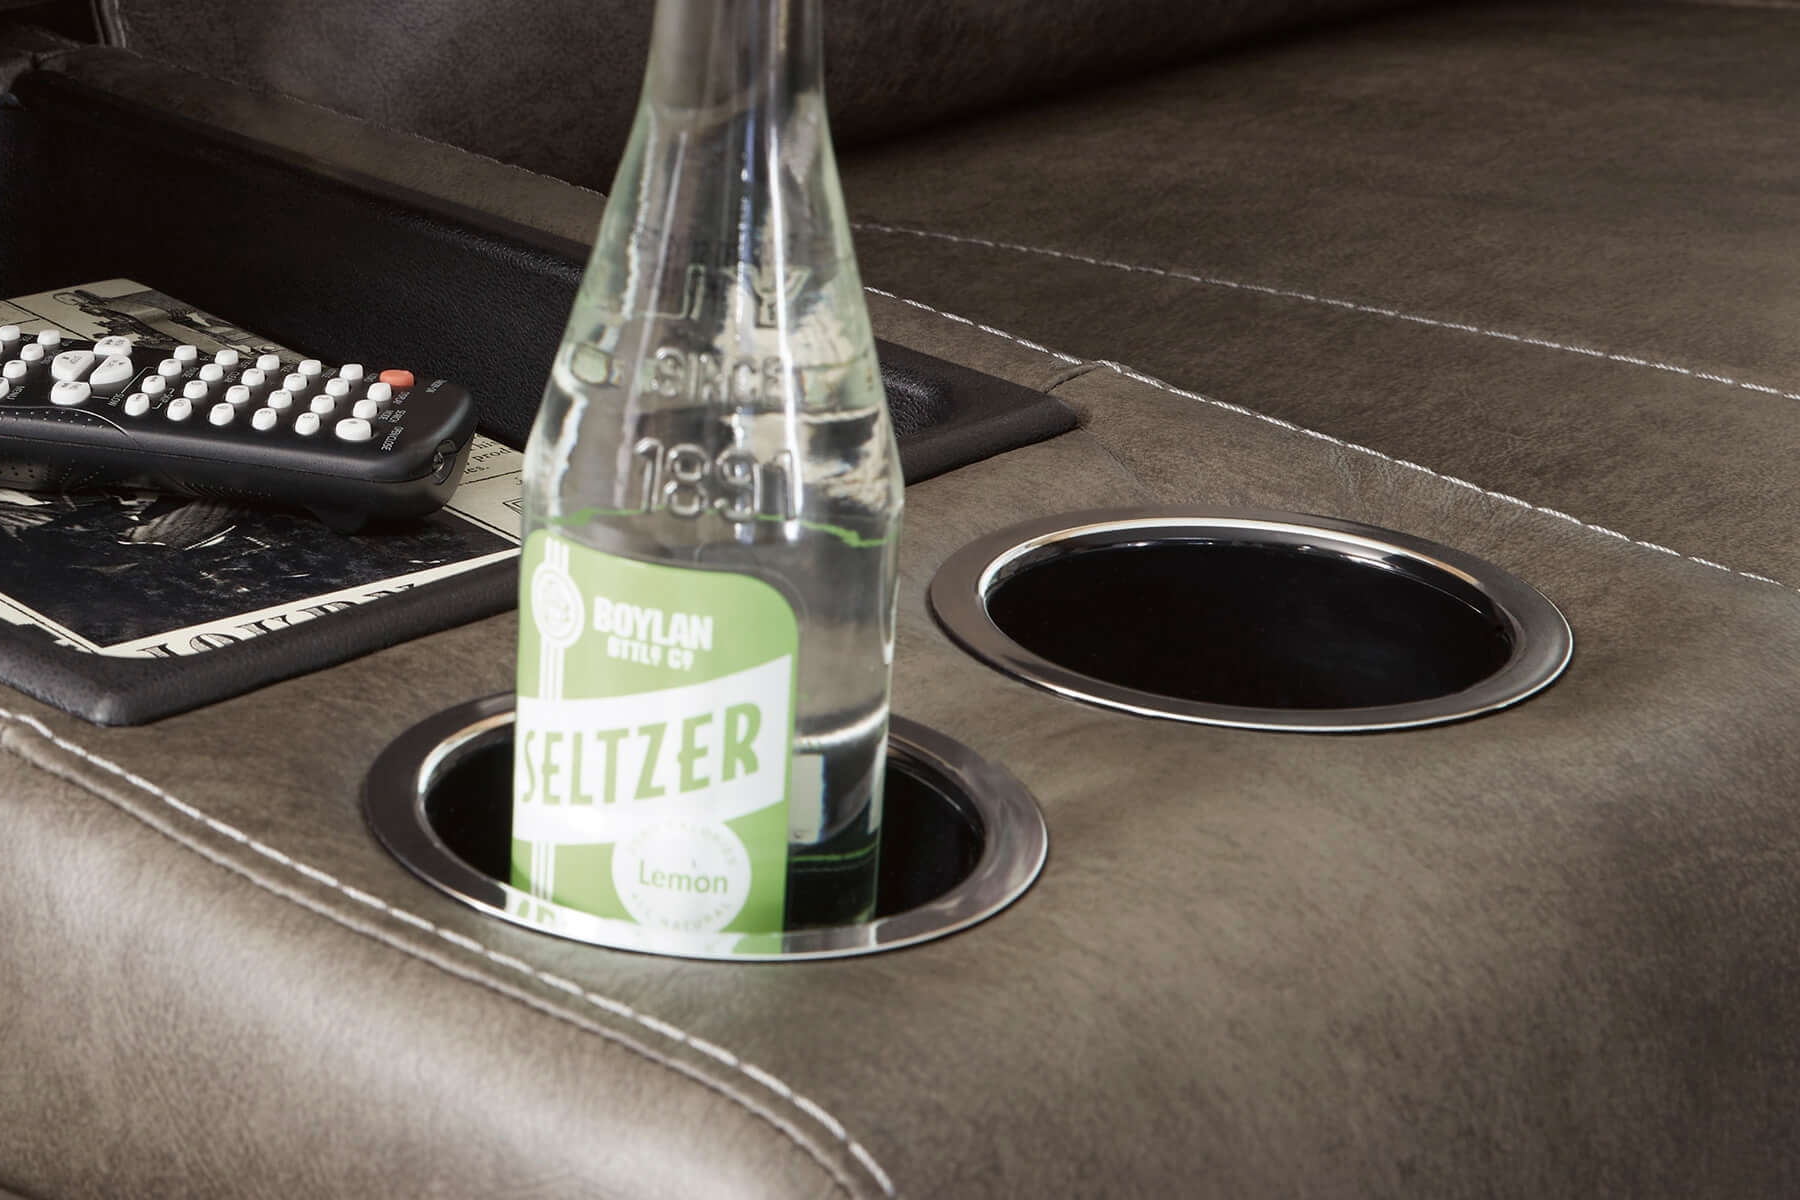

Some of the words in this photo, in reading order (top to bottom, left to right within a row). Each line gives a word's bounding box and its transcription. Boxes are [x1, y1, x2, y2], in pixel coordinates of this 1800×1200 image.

[7, 386, 25, 400] MENU
[107, 392, 124, 407] SLOW
[380, 425, 404, 452] OPEN/CLOSE
[634, 436, 797, 520] 1891
[593, 596, 713, 651] BOYLAN
[522, 702, 762, 805] SELTZER
[639, 858, 729, 895] Lemon
